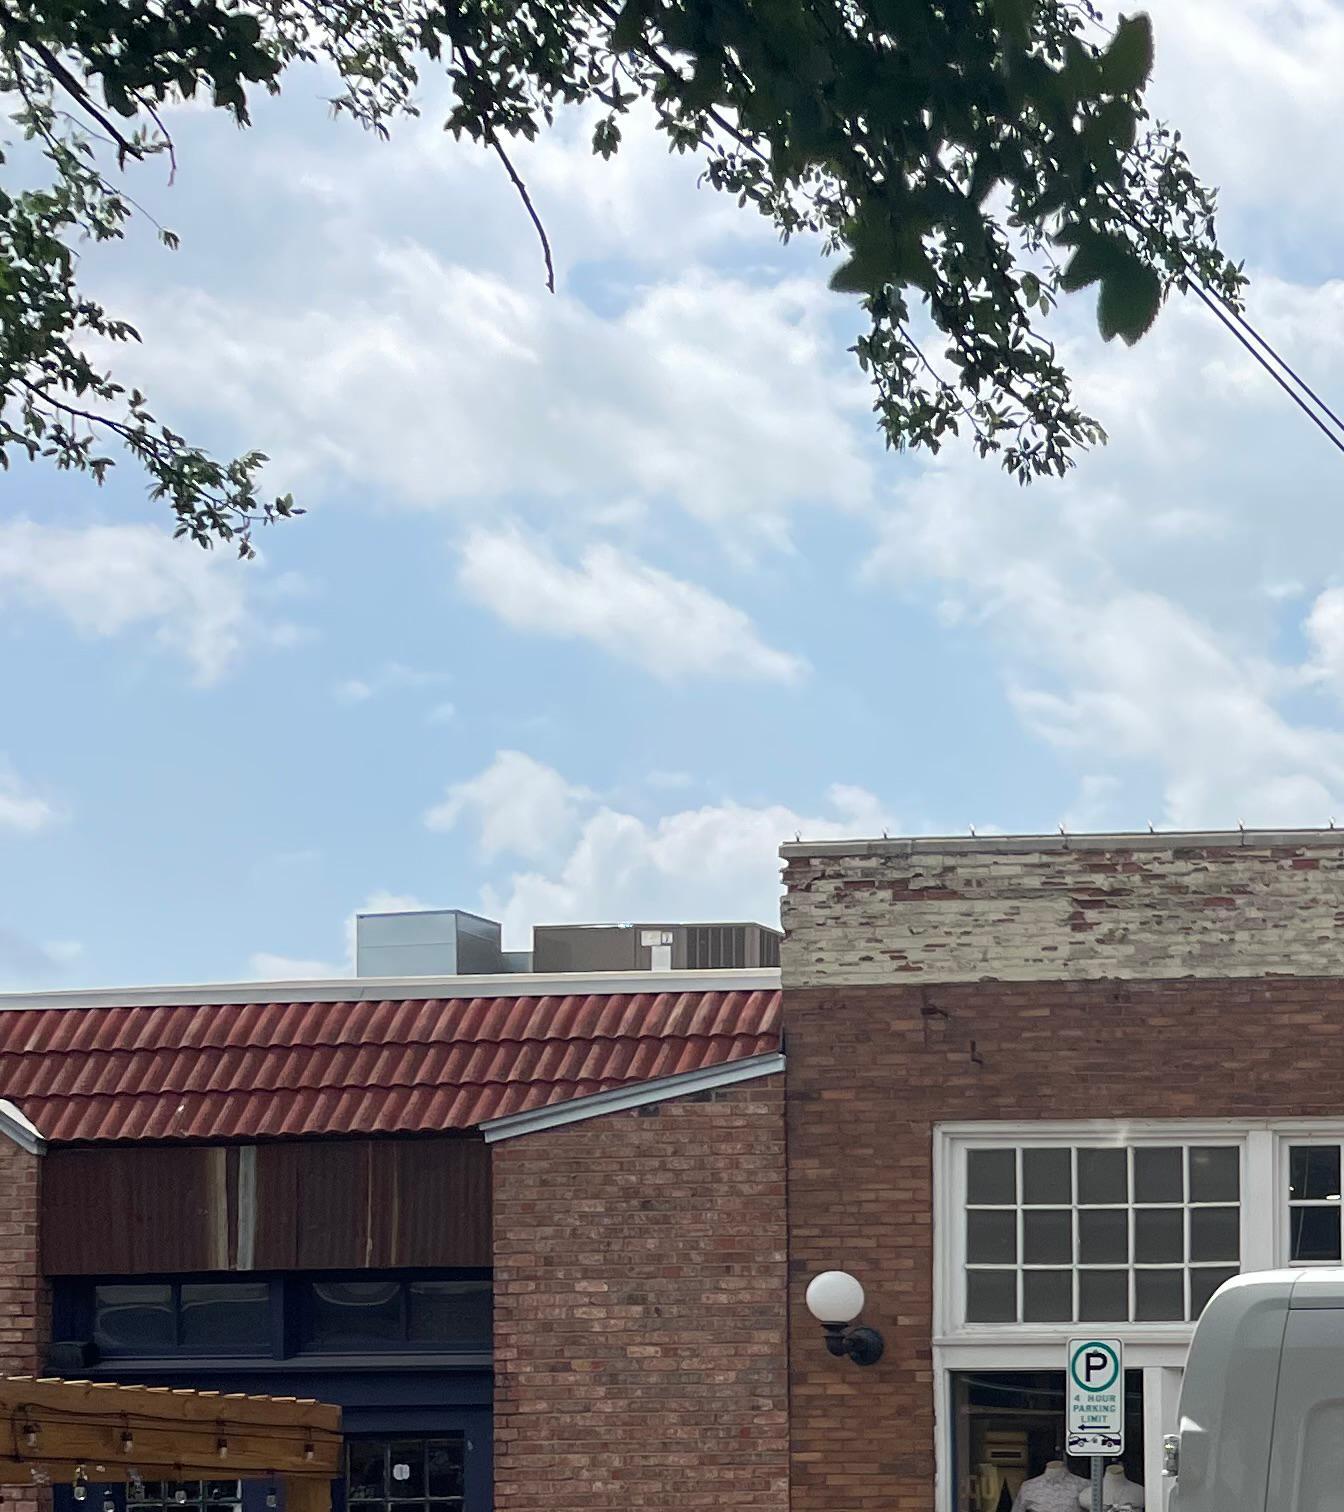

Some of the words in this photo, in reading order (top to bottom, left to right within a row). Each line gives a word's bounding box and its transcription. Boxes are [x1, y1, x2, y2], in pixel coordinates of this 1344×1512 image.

[1086, 1352, 1107, 1382] P
[1074, 1394, 1081, 1402] 4
[1087, 1394, 1116, 1402] HOUR
[1073, 1404, 1116, 1413] PARKING
[1080, 1415, 1107, 1423] LIMIT
